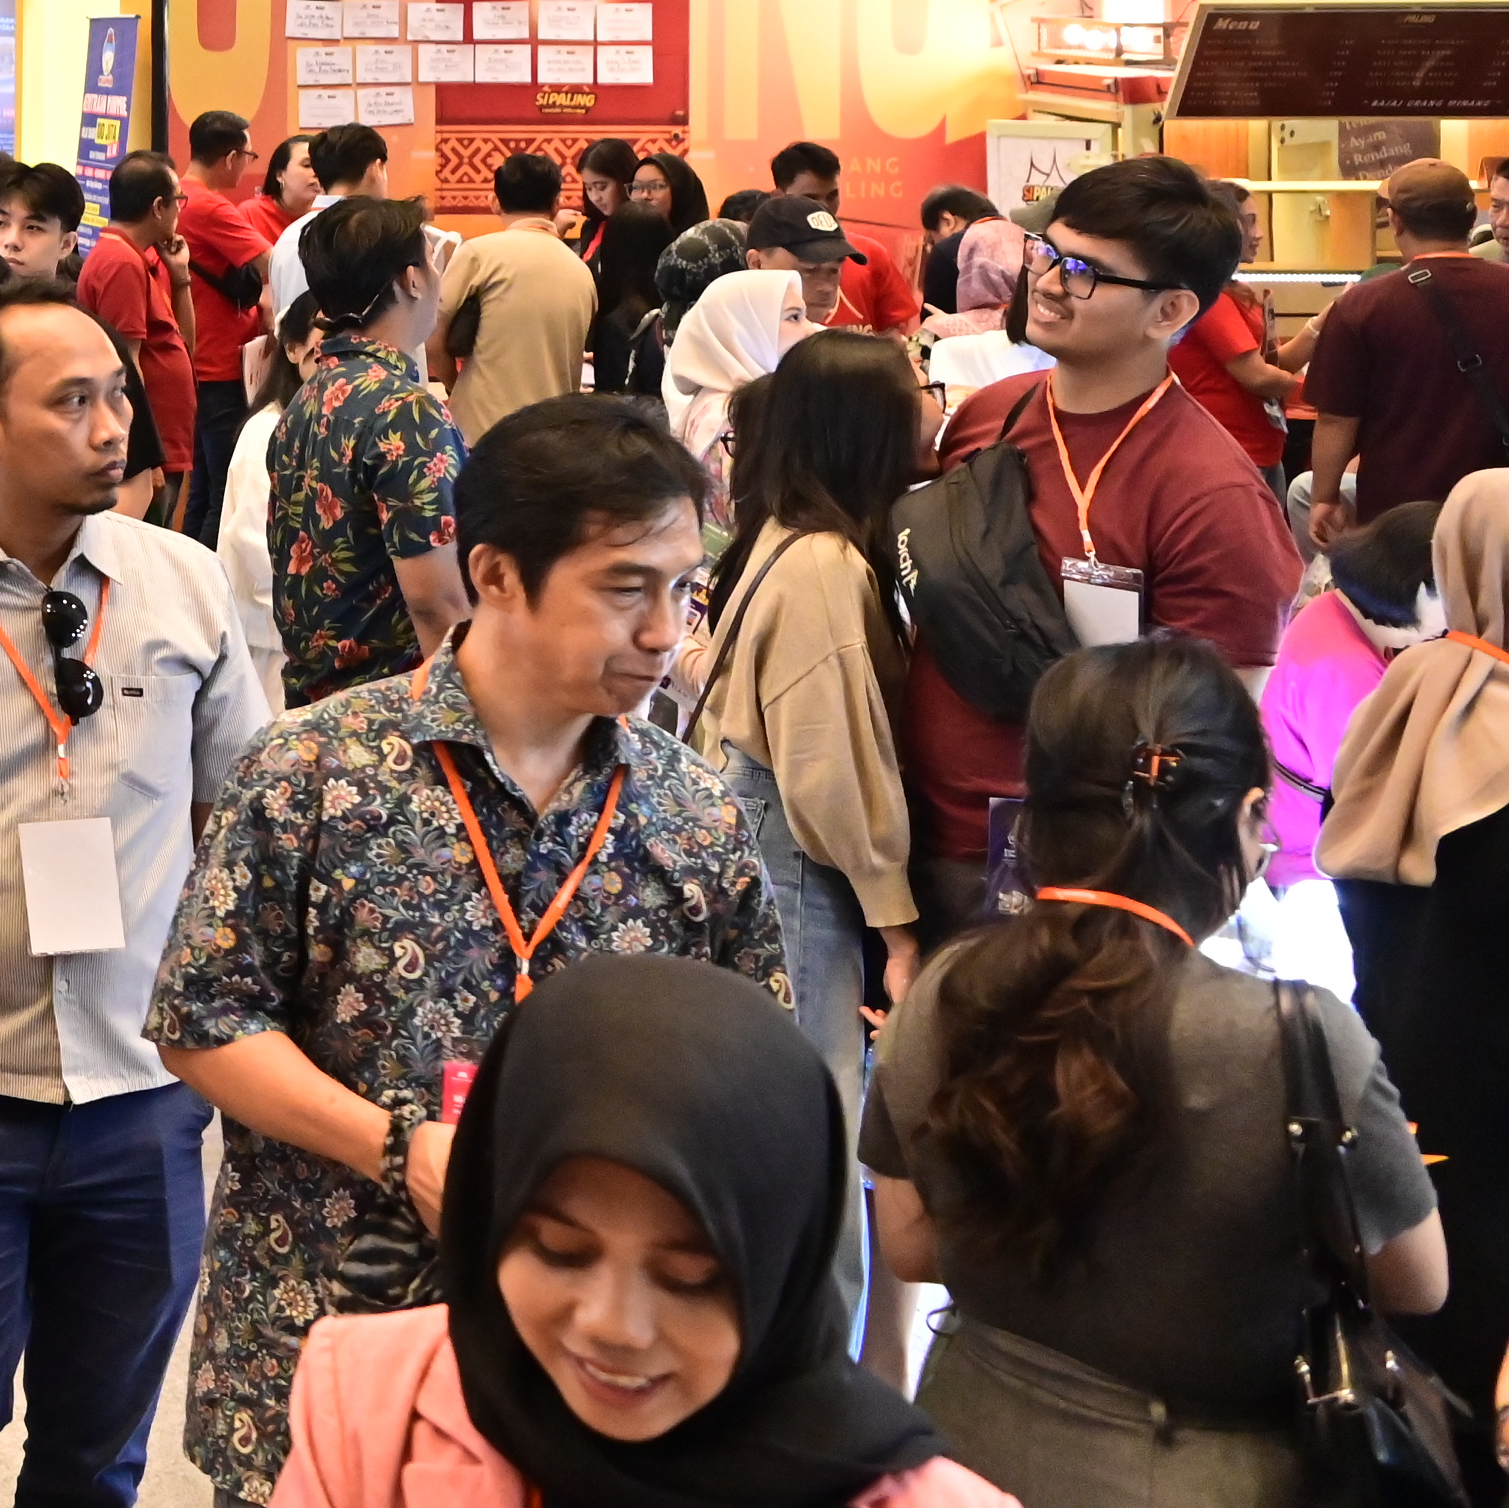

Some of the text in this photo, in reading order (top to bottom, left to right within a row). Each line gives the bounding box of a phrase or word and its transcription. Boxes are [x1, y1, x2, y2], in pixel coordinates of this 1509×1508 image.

[1213, 17, 1260, 30] Menu
[1350, 130, 1387, 149] Ayam
[1353, 142, 1413, 165] Rendang
[848, 156, 900, 174] ANG
[846, 181, 904, 199] LING
